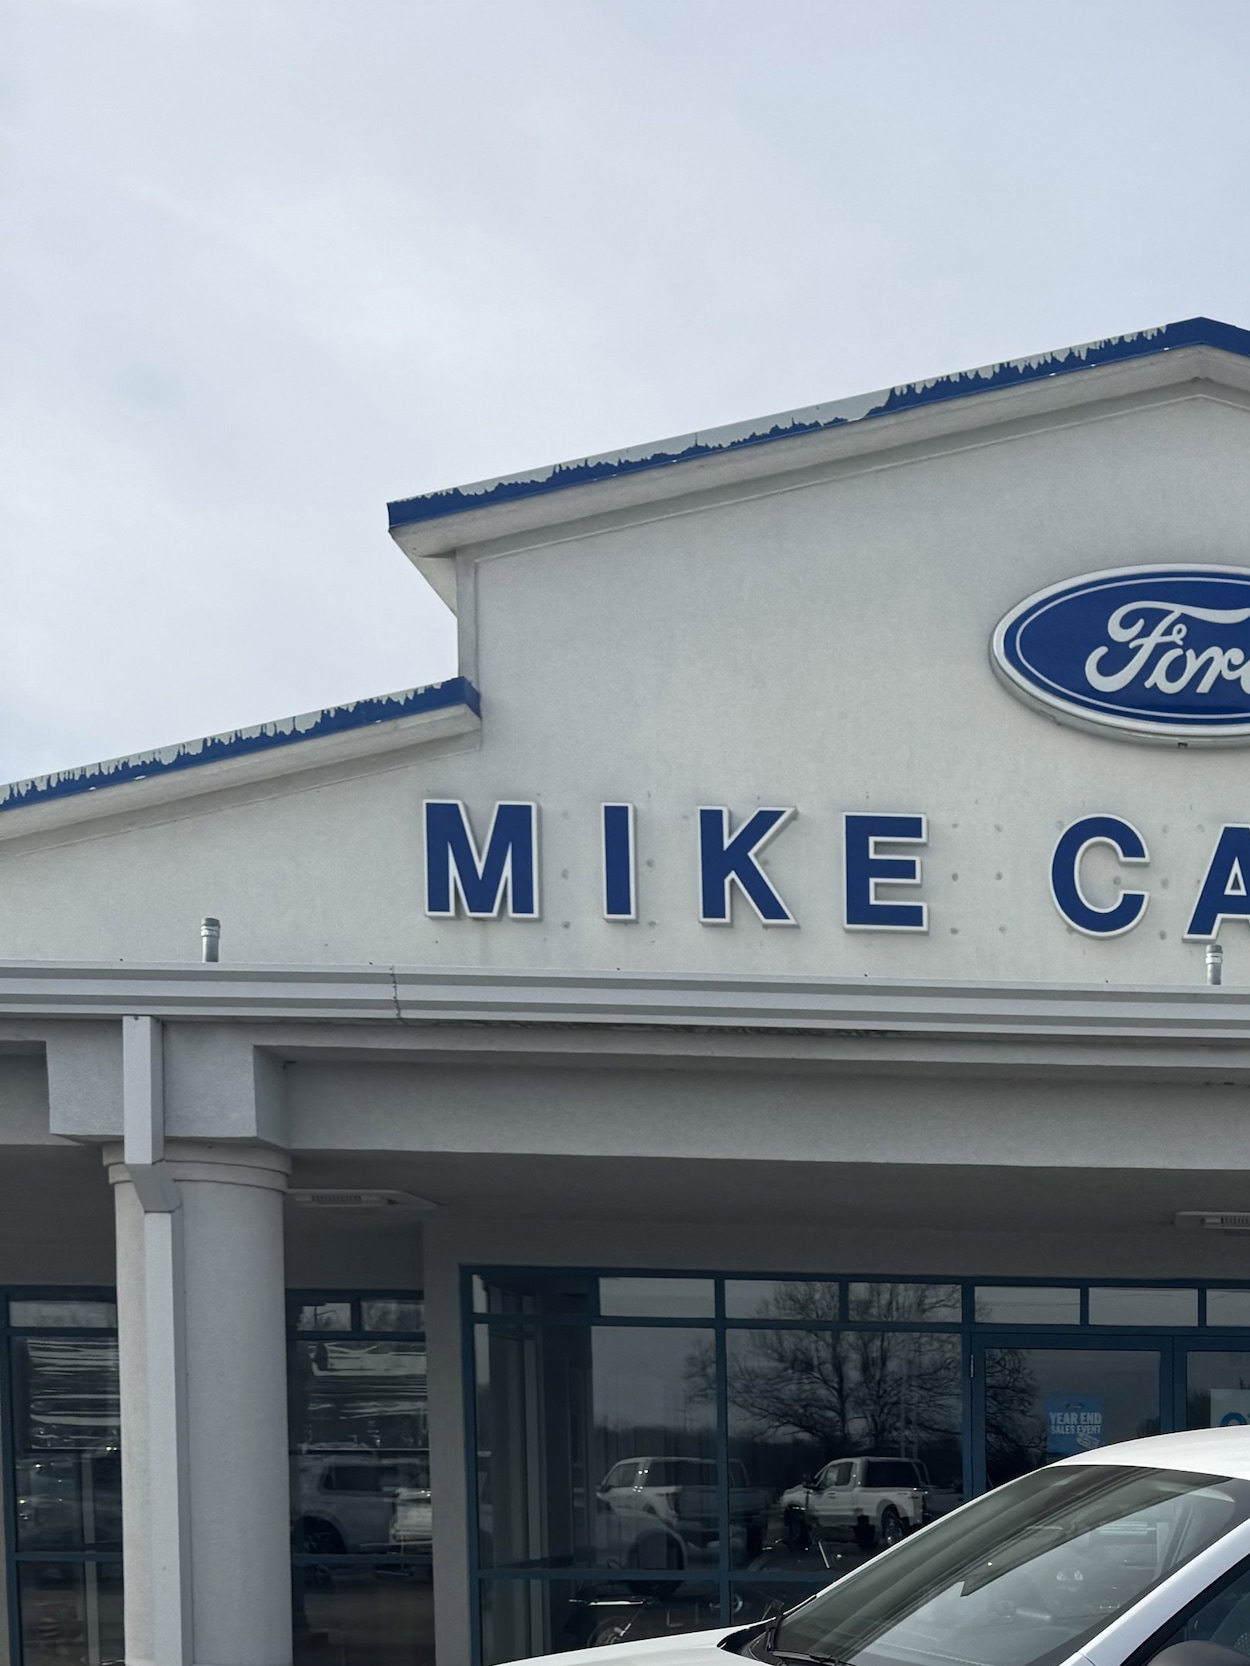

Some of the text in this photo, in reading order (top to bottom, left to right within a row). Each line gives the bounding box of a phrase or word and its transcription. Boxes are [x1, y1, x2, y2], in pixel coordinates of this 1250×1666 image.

[424, 799, 928, 932] MIKE
[1049, 1412, 1102, 1424] YEAR END
[1050, 1425, 1101, 1434] SALES EVENT
